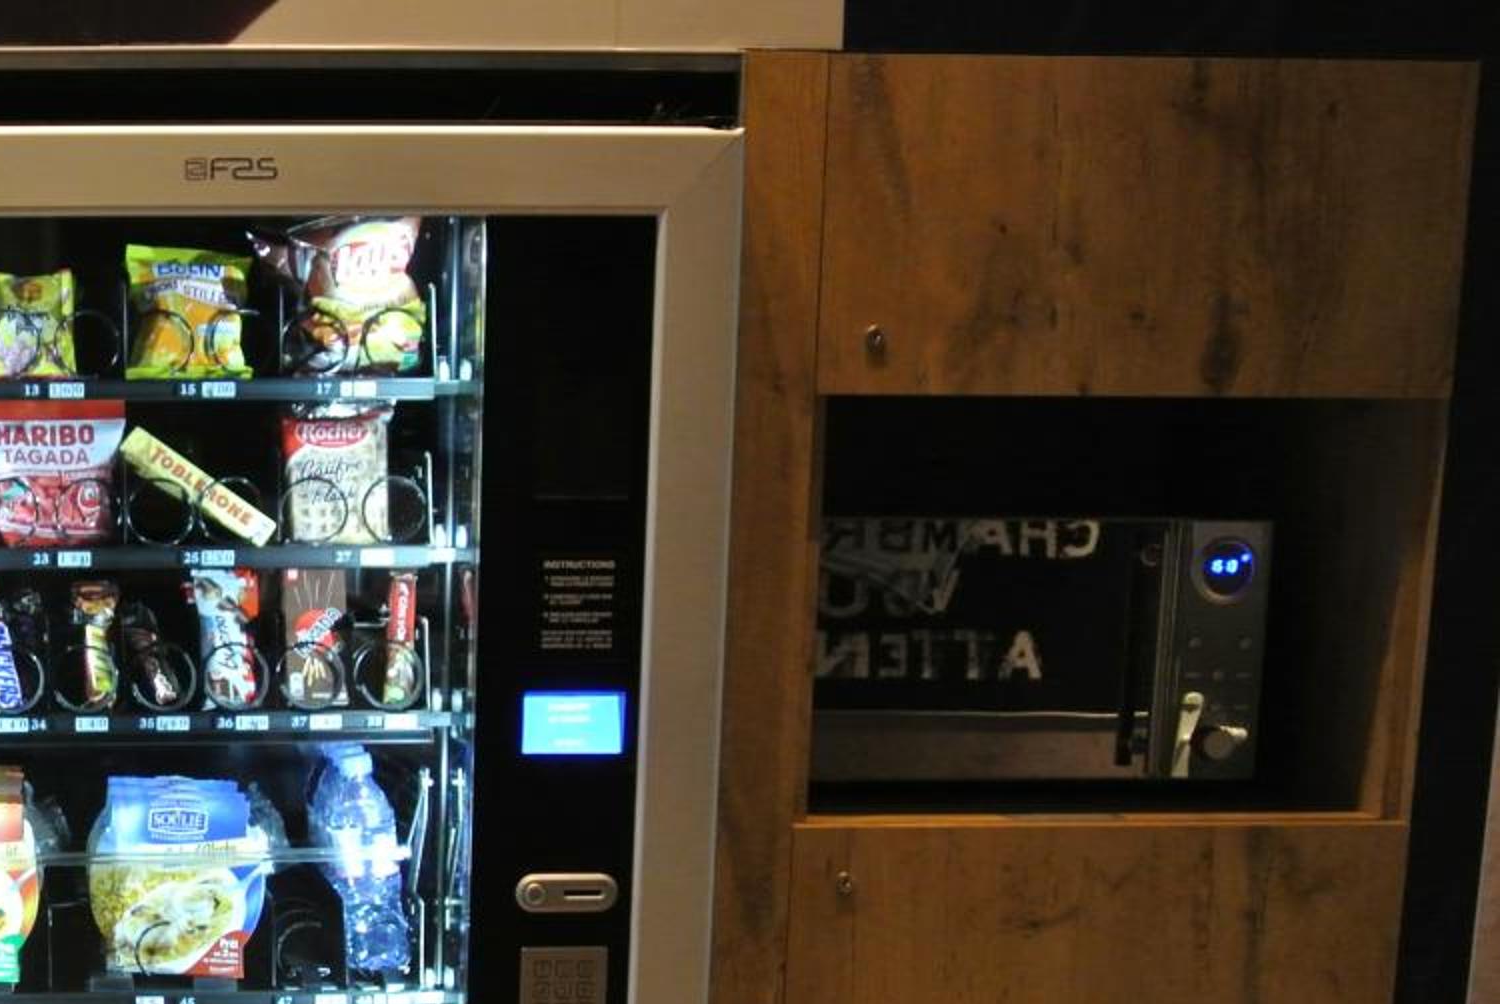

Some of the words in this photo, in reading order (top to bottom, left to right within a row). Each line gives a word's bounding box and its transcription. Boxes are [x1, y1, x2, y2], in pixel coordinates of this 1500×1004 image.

[180, 384, 196, 395] 15
[316, 383, 331, 395] 17
[3, 448, 90, 465] TAGADA
